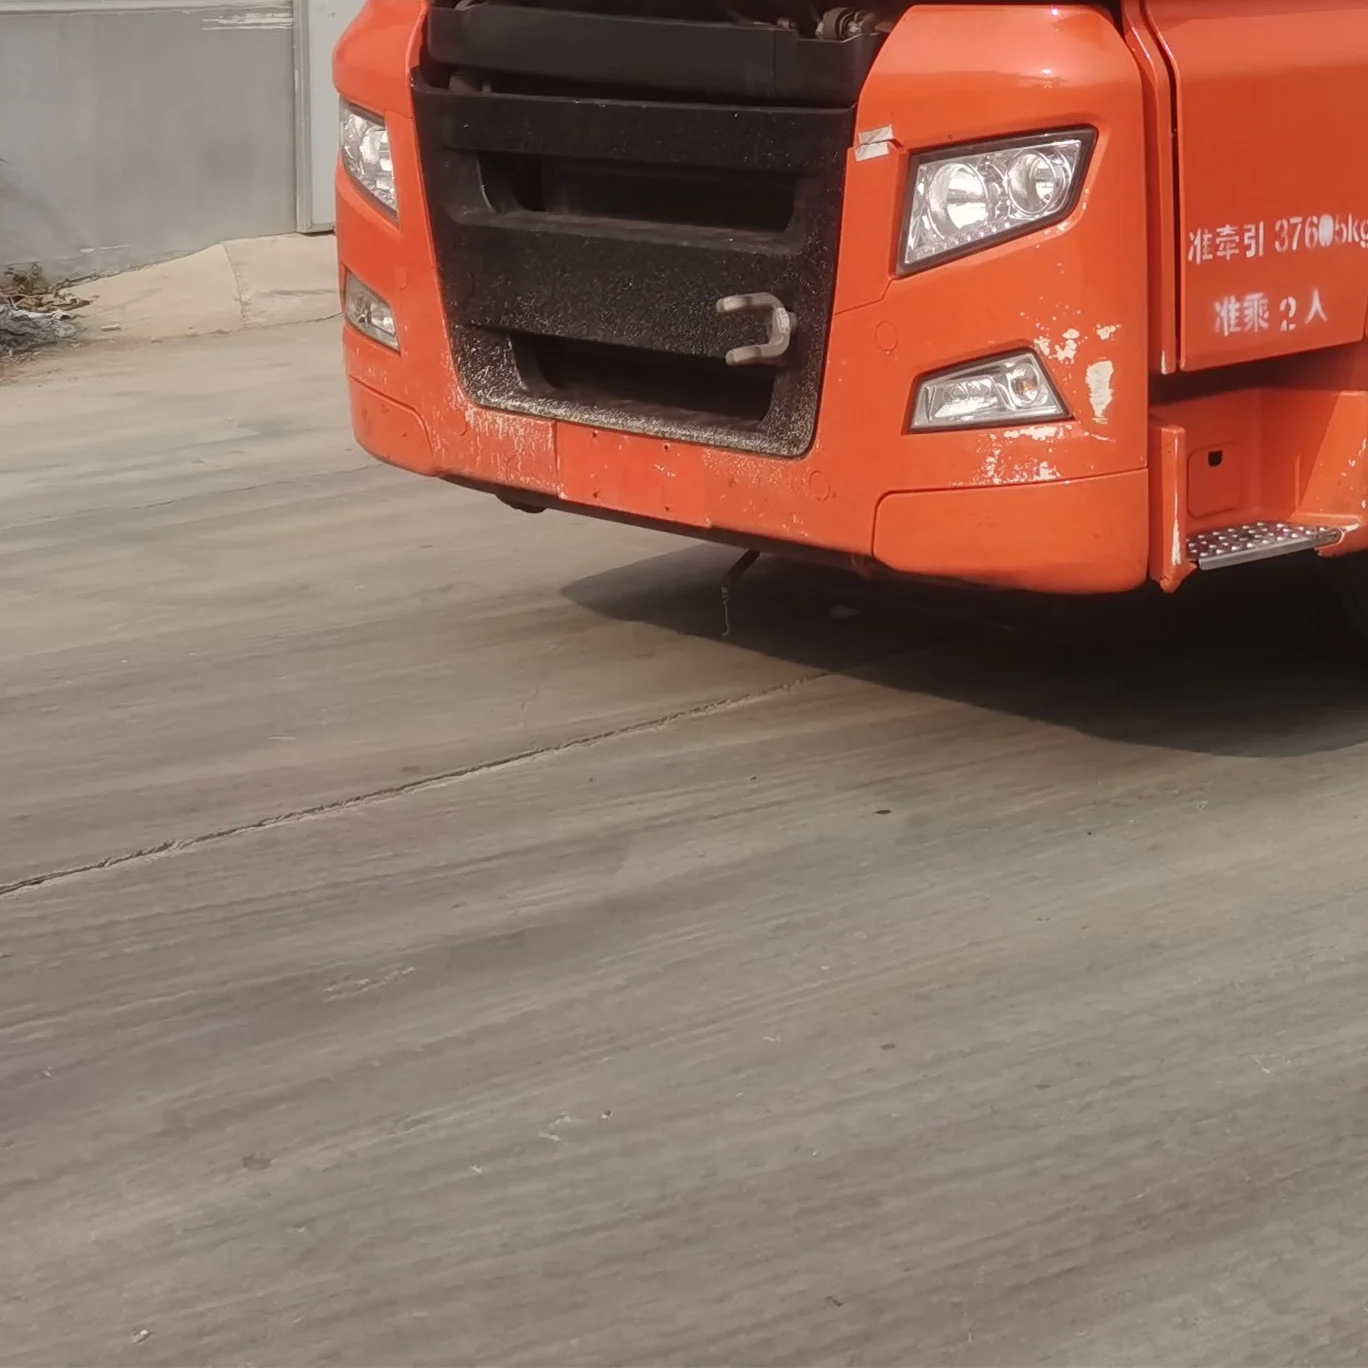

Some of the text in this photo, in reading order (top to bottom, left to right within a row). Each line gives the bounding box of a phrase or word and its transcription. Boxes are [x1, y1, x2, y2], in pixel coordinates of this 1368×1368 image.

[1188, 221, 1264, 264] 准牵引
[1214, 288, 1328, 337] 准乘 2 人
